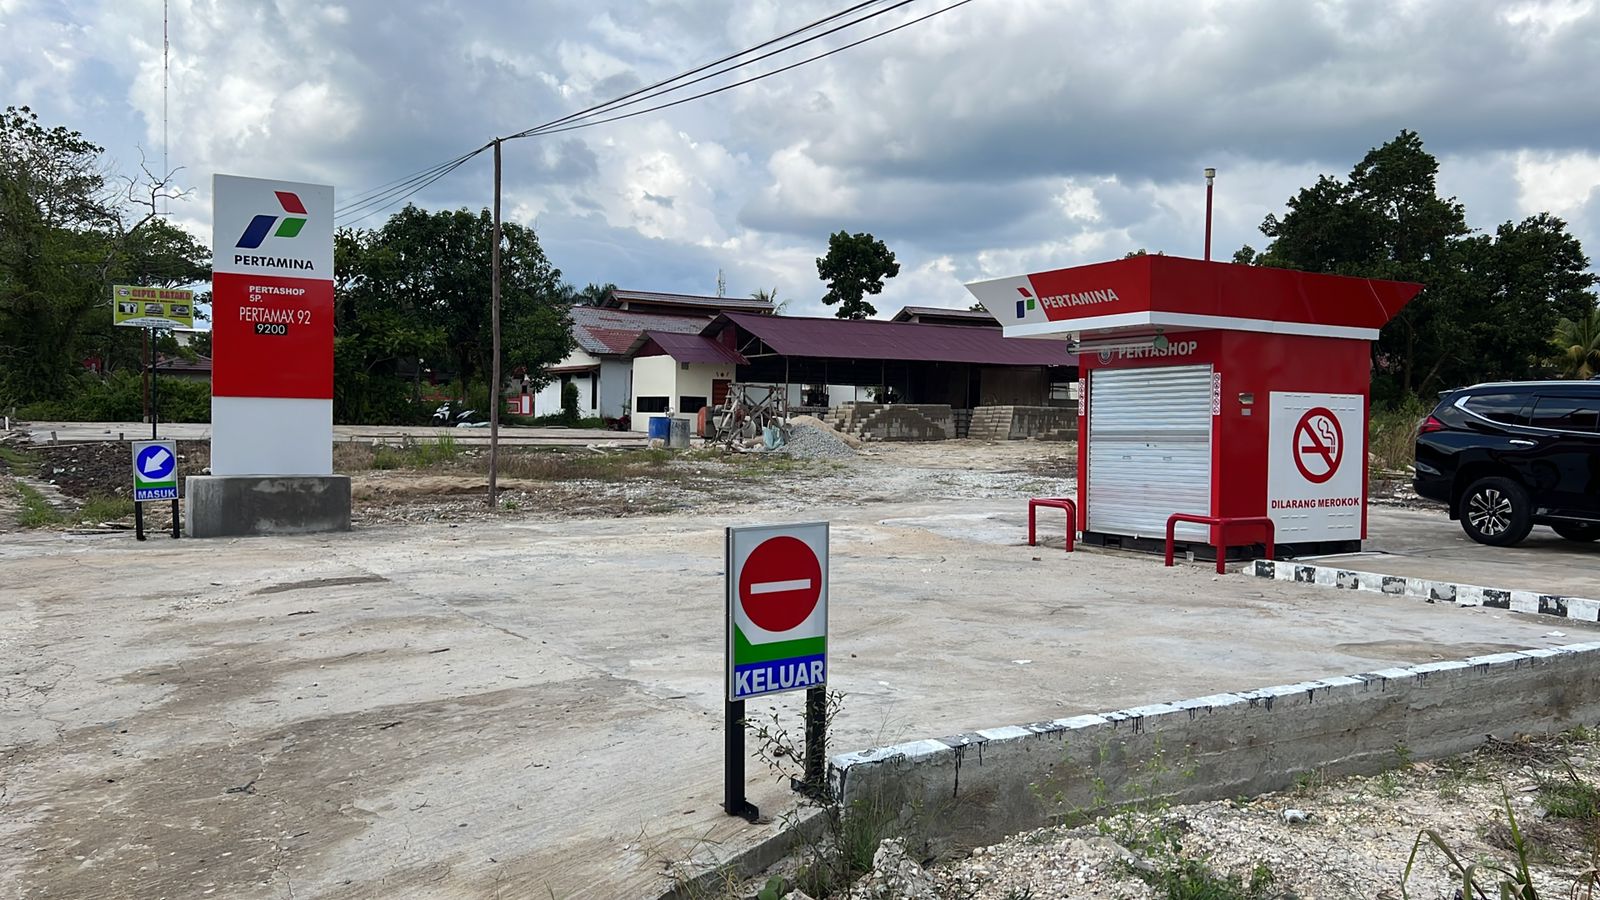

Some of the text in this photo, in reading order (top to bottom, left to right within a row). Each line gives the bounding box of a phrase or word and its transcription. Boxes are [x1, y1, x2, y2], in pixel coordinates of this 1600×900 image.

[234, 255, 314, 270] PERTAMINA
[249, 285, 305, 296] PERTASHOP
[1041, 288, 1119, 309] PERTAMINA
[239, 306, 311, 325] PERTAMAX 92
[257, 323, 286, 335] 9200
[1118, 341, 1197, 359] PERTASHOP
[137, 488, 175, 499] MASUK
[1271, 497, 1360, 509] DILARANG MEROKOK
[735, 660, 824, 695] KELUAR
